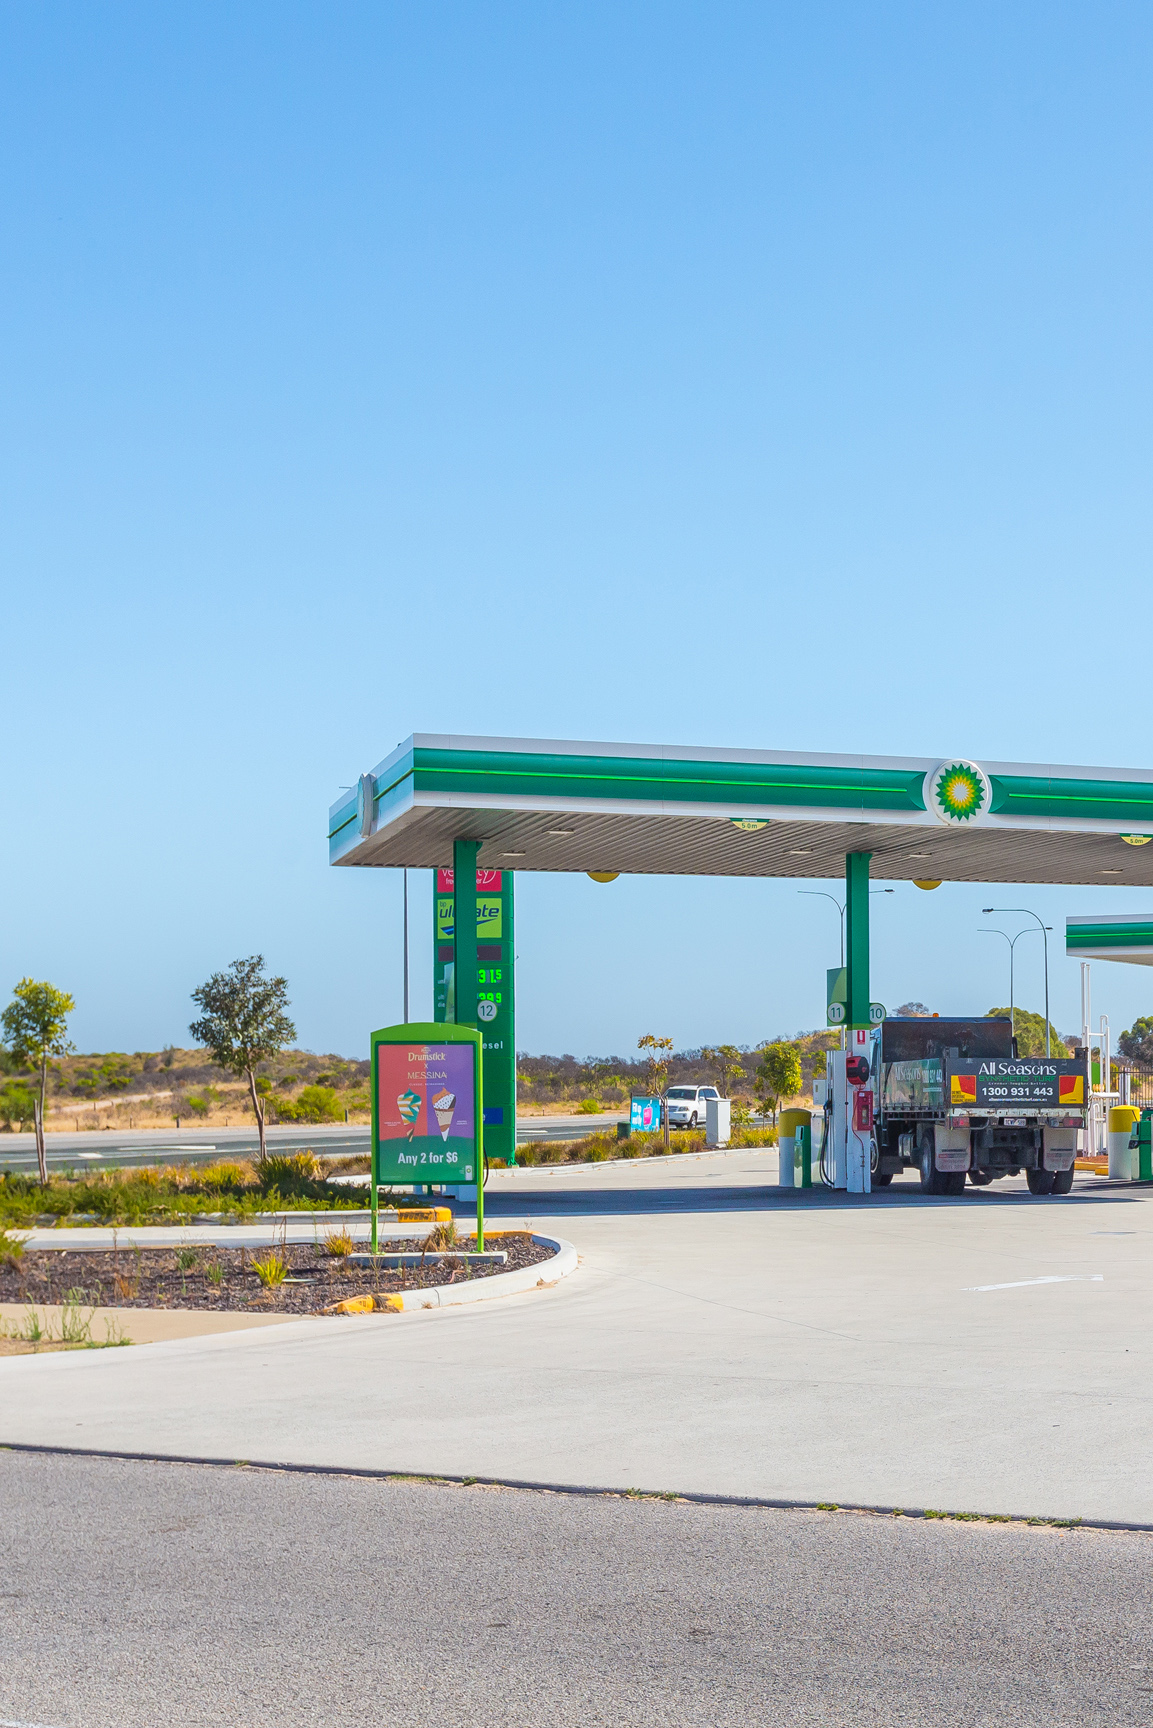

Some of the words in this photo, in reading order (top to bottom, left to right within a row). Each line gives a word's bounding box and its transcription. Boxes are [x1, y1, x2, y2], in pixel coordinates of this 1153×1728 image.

[480, 1005, 493, 1016] 12
[831, 1007, 841, 1018] 11
[870, 1008, 882, 1019] 10
[408, 1052, 446, 1062] Drumstick
[978, 1062, 995, 1075] All
[998, 1062, 1057, 1075] Seasons
[407, 1071, 447, 1079] MESSINA
[982, 1087, 1008, 1096] 1300
[1010, 1087, 1030, 1096] 931
[1033, 1087, 1054, 1096] 443
[397, 1152, 418, 1166] Any
[420, 1153, 427, 1163] 2
[429, 1152, 443, 1163] for
[446, 1151, 458, 1163] $6
